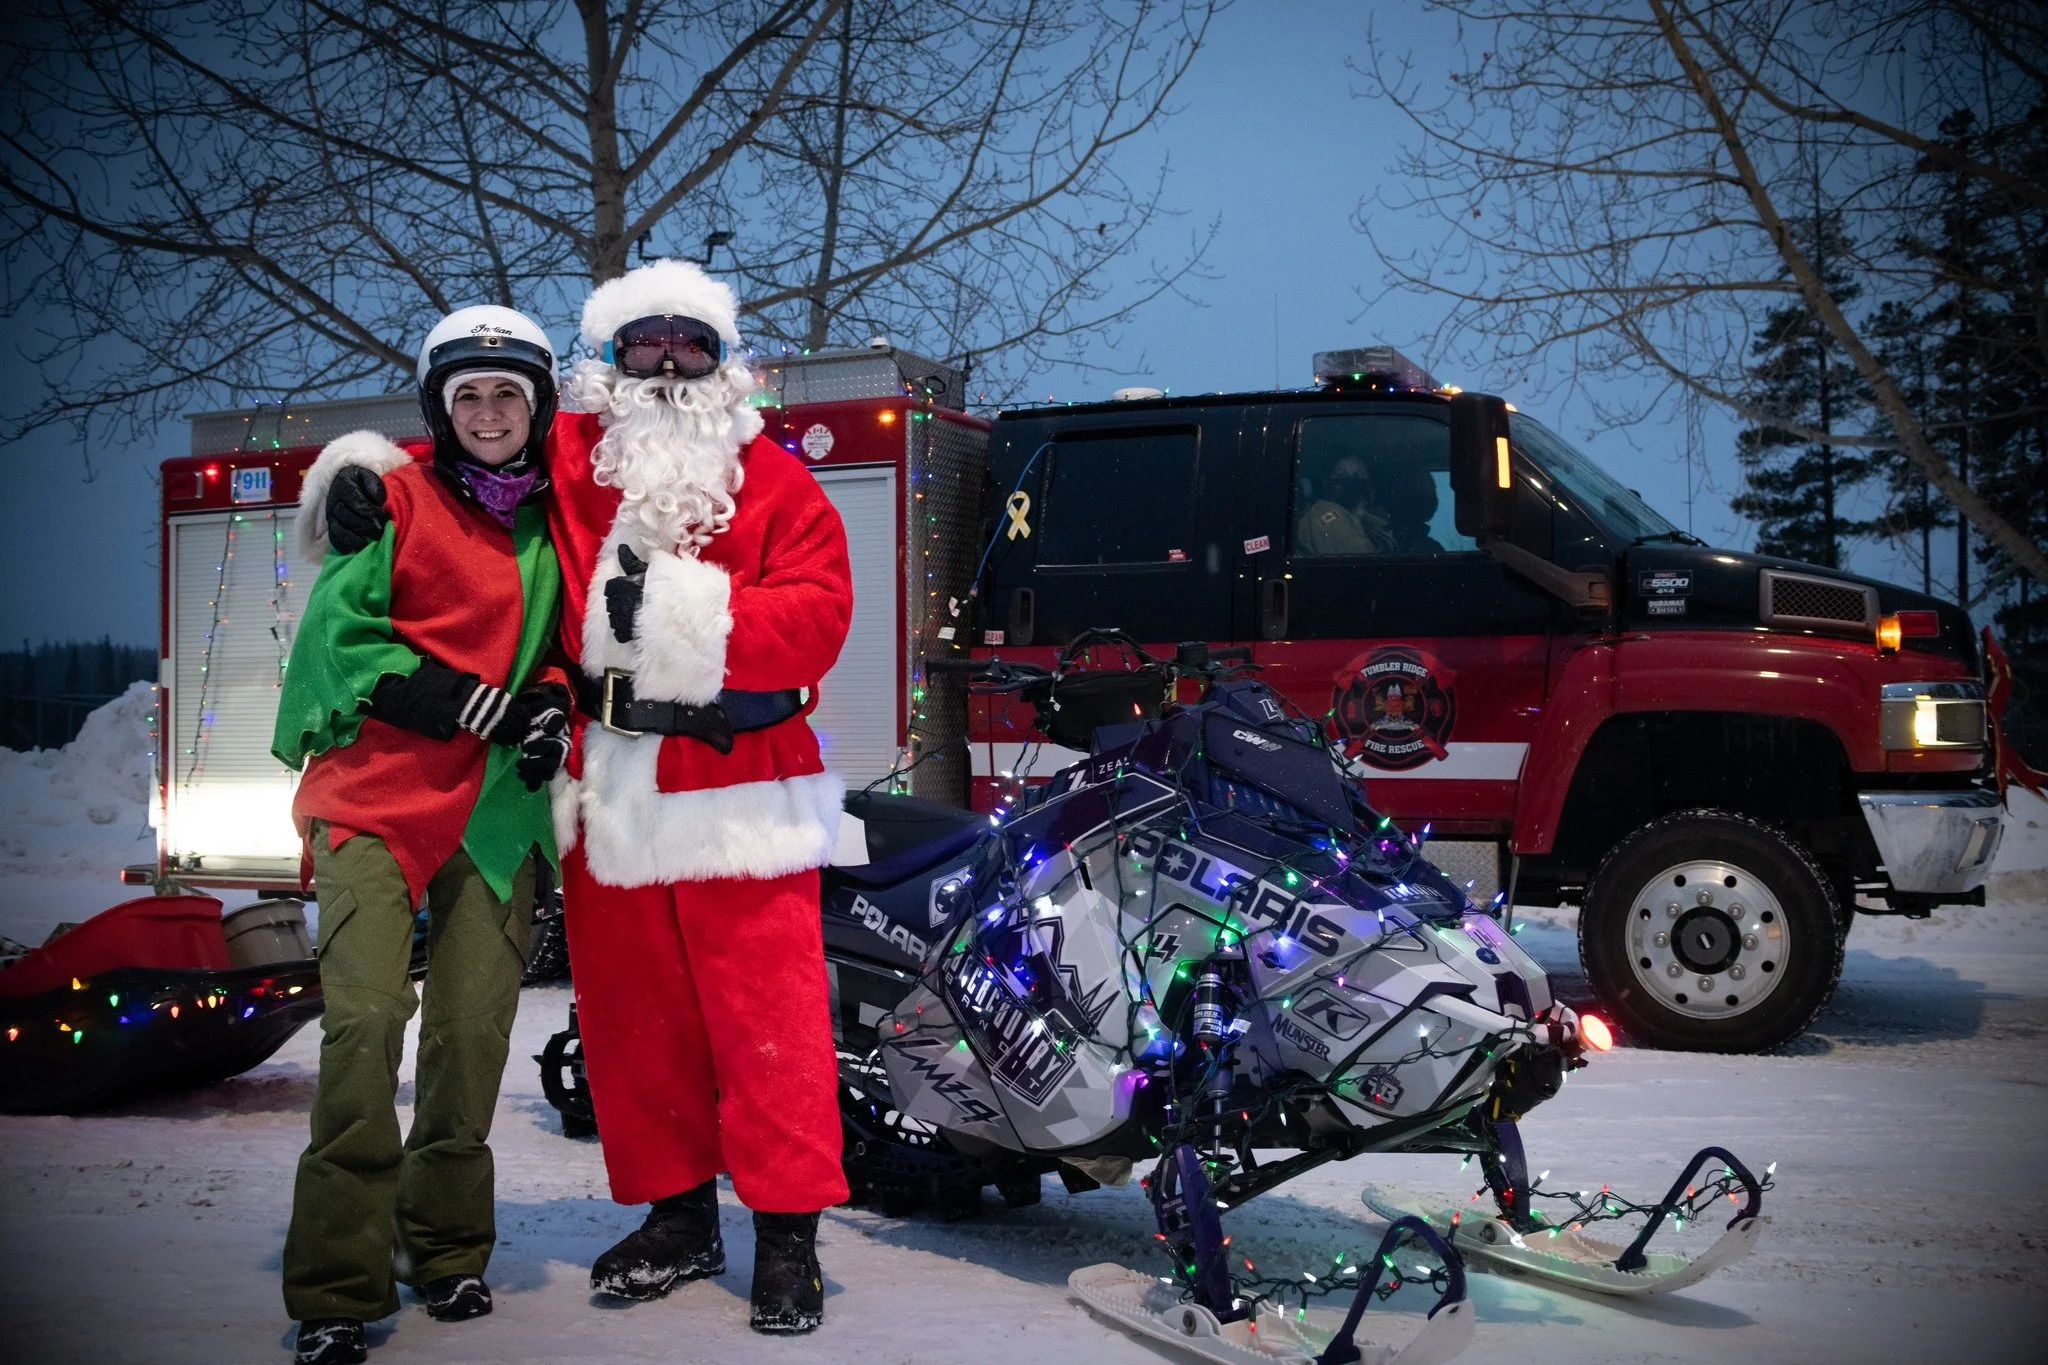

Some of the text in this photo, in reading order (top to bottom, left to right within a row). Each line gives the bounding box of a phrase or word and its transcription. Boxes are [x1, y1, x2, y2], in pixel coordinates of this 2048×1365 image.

[1245, 537, 1270, 552] CLEAN
[1360, 662, 1428, 677] TUMBLER RIDGE
[1365, 740, 1425, 754] FIRE RESCUE
[1119, 827, 1346, 957] POLARIS
[849, 894, 930, 963] POLAR
[1271, 1012, 1332, 1062] MUNSTER
